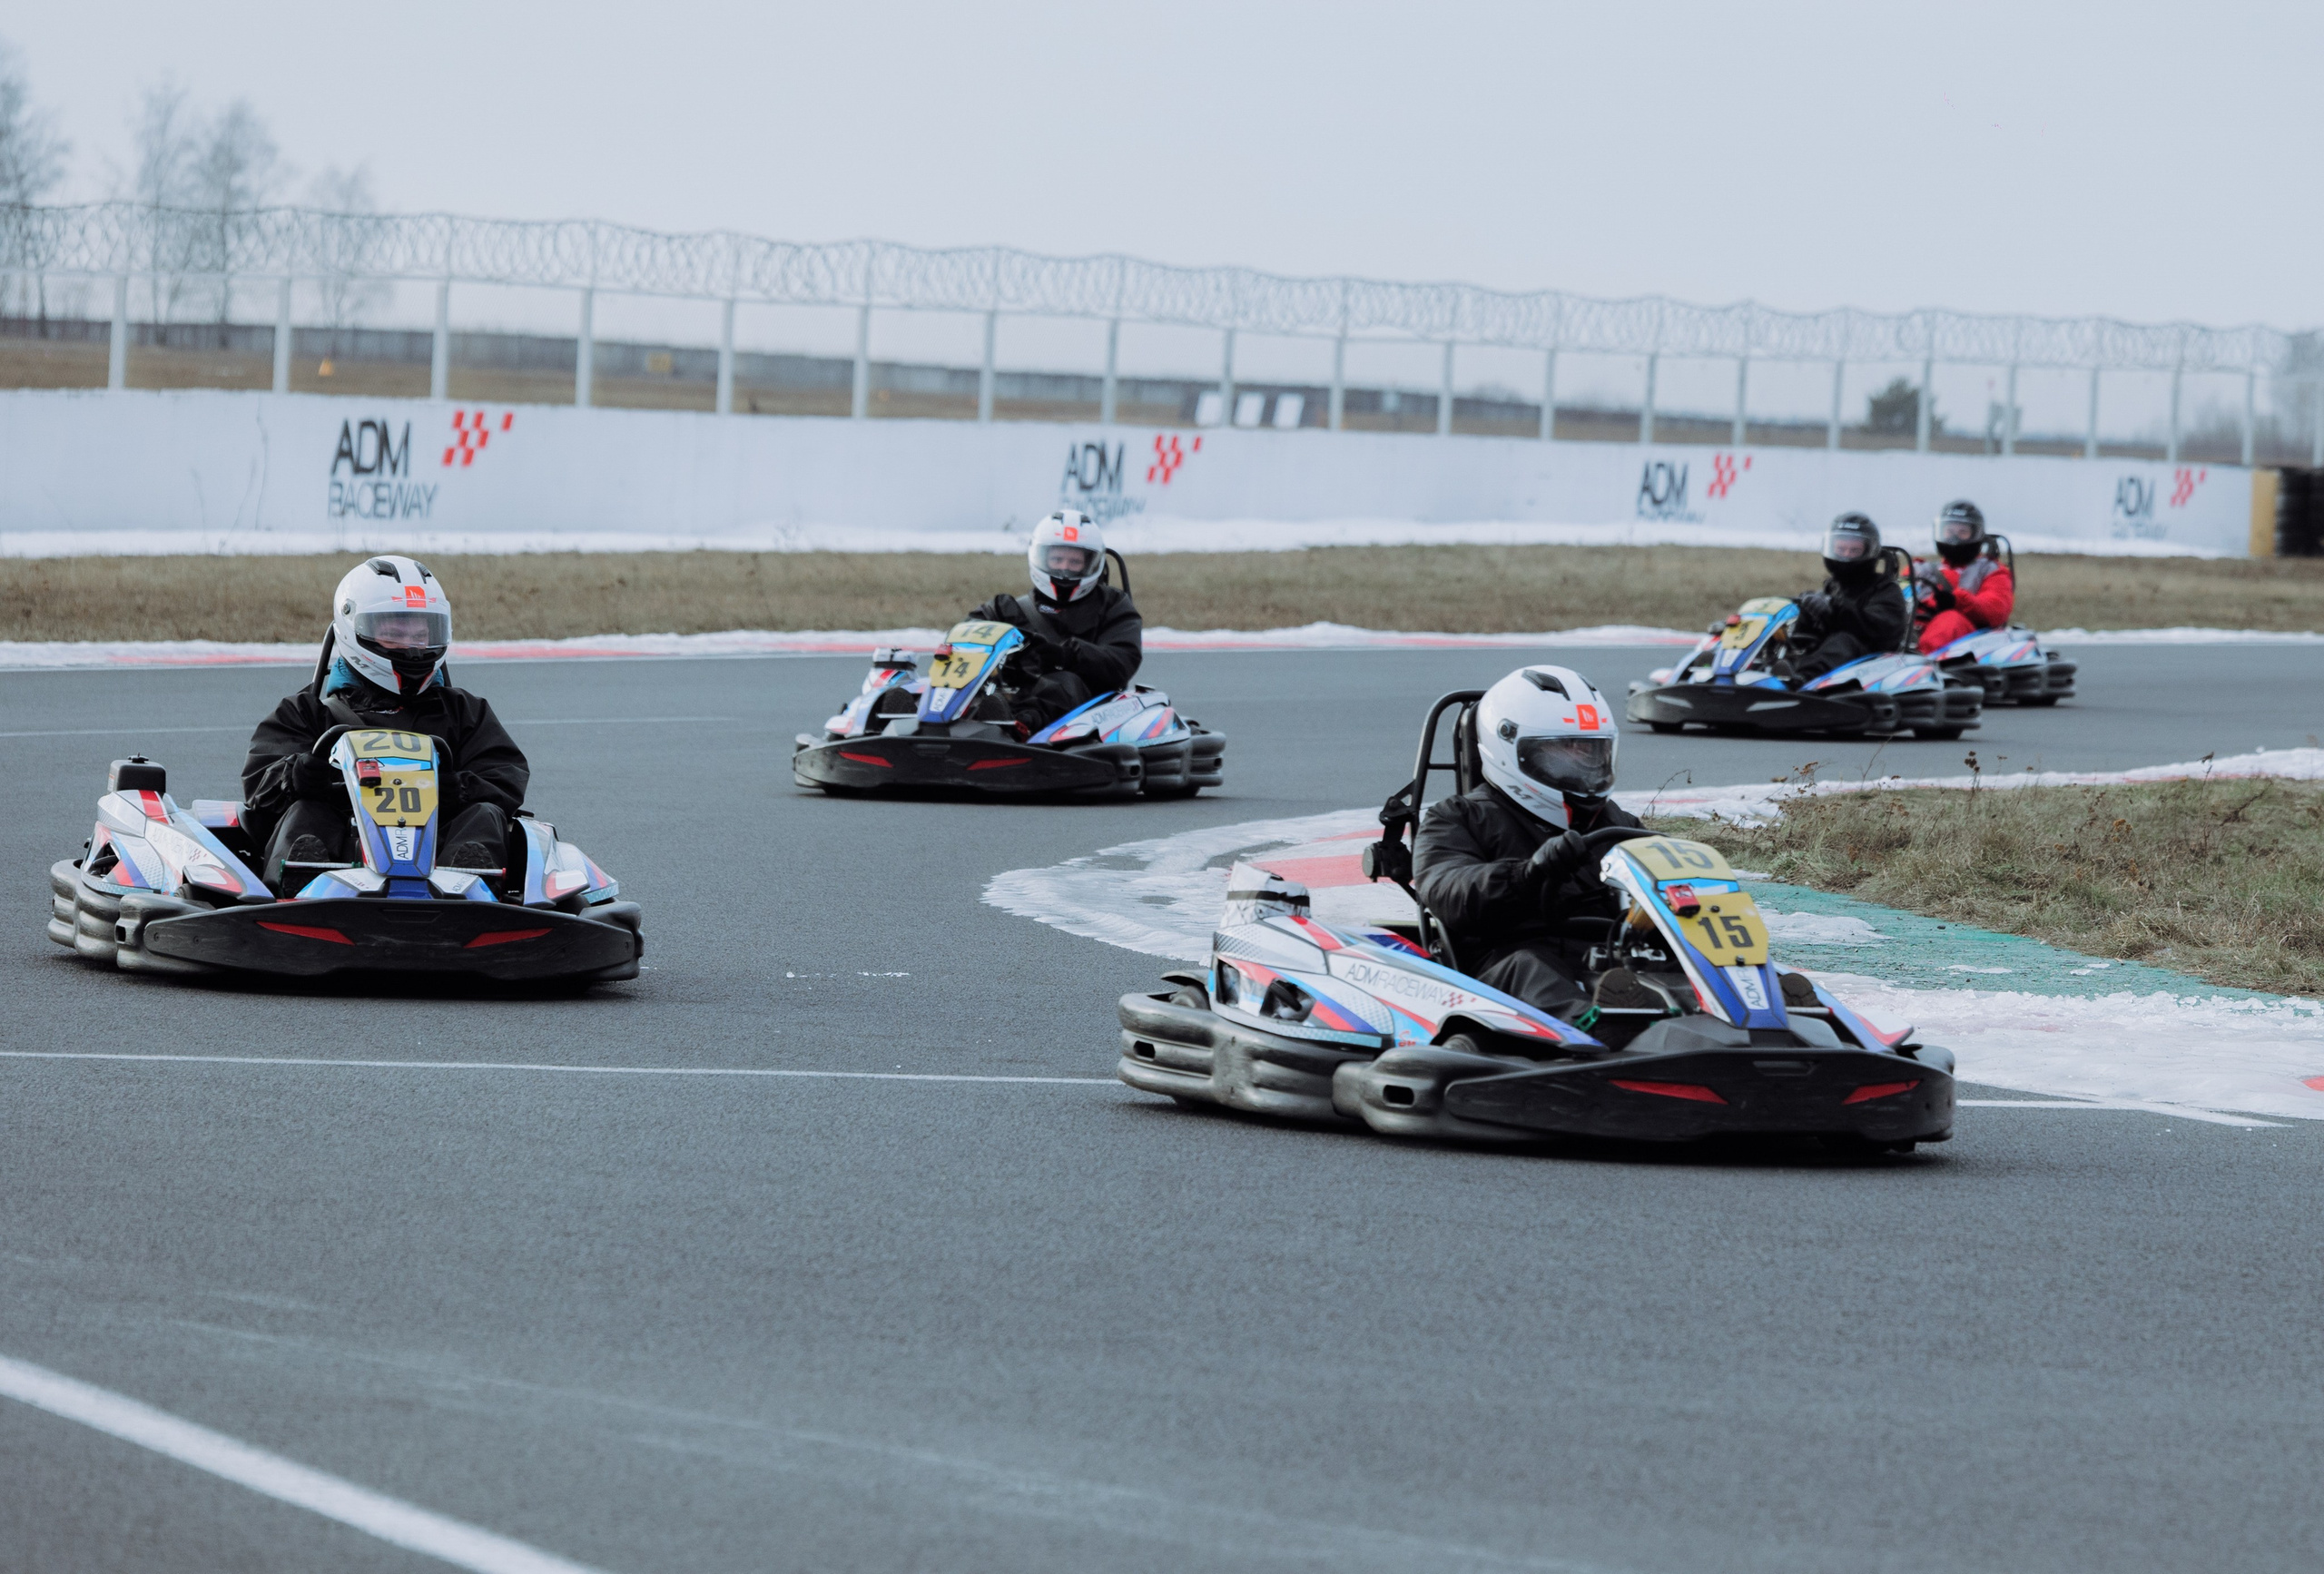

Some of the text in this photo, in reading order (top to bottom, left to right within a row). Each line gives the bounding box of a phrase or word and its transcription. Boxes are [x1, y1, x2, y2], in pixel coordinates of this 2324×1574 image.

[330, 418, 410, 477] ADM
[1060, 442, 1125, 493] ADM
[961, 625, 997, 638] 14
[940, 660, 970, 678] 14
[359, 731, 422, 753] 20
[374, 787, 422, 813] 20
[1646, 841, 1715, 870] 15
[1697, 915, 1755, 949] 15
[1344, 962, 1449, 1005] ADMRACEWAY
